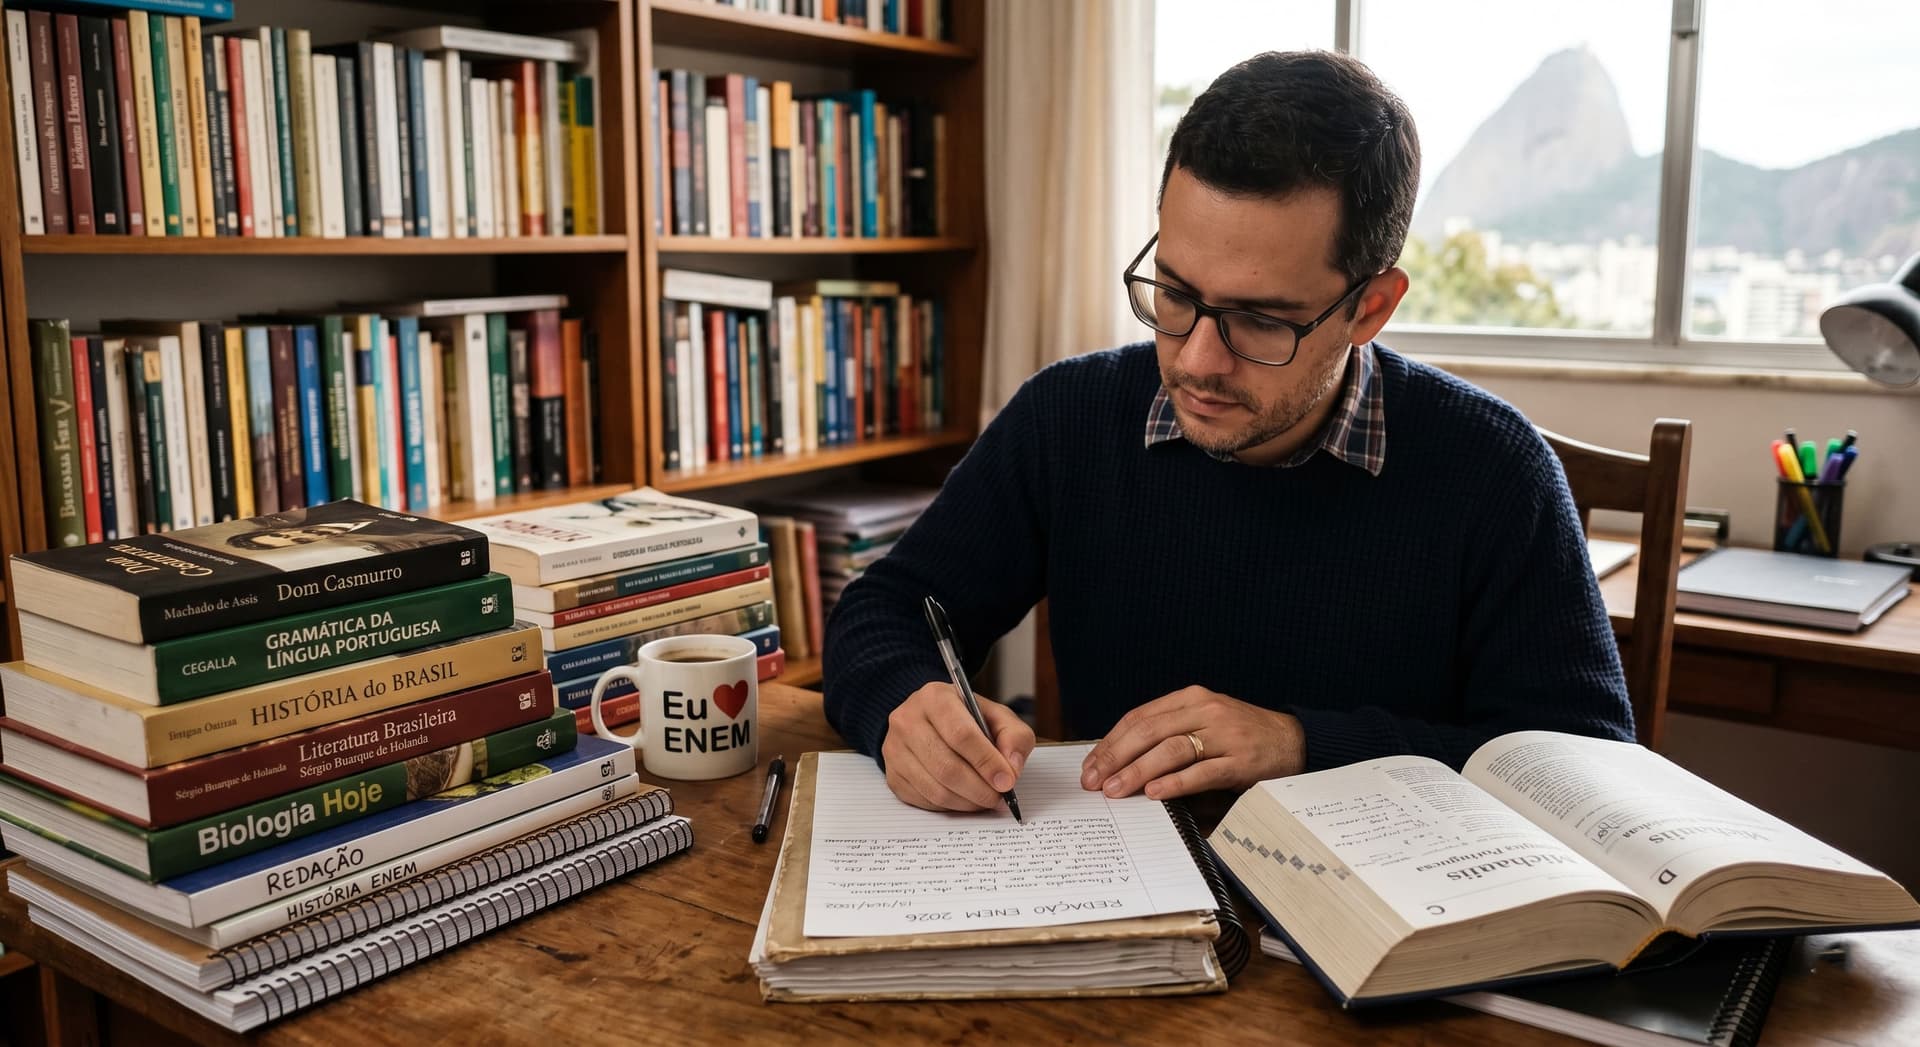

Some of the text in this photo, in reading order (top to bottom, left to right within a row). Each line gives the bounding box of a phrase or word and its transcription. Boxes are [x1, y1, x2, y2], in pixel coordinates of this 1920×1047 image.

[277, 567, 402, 601] Dom Casmurro
[164, 594, 258, 620] Machado de Assis
[266, 611, 394, 650] GRAMÁTICA DA
[266, 619, 441, 670] LÍNGUA PORTUGUESA
[182, 656, 237, 676] CEGALLA
[250, 661, 458, 727] HISTÓRIA do BRASIL
[663, 691, 708, 720] Eu
[299, 706, 457, 762] Literatura Brasileira
[664, 722, 750, 752] ENEM
[300, 735, 429, 780] Sérgio Buarque de Holanda
[175, 763, 287, 800] Sérgio Buarque de Holanda
[198, 782, 383, 856] Biologia Hoje
[267, 845, 364, 896] REDAÇÃO
[1658, 869, 1677, 885] D
[287, 861, 418, 922] HISTÓRIA ENEM
[905, 911, 953, 922] 2026
[966, 908, 1021, 918] ENEM
[1426, 905, 1446, 915] C
